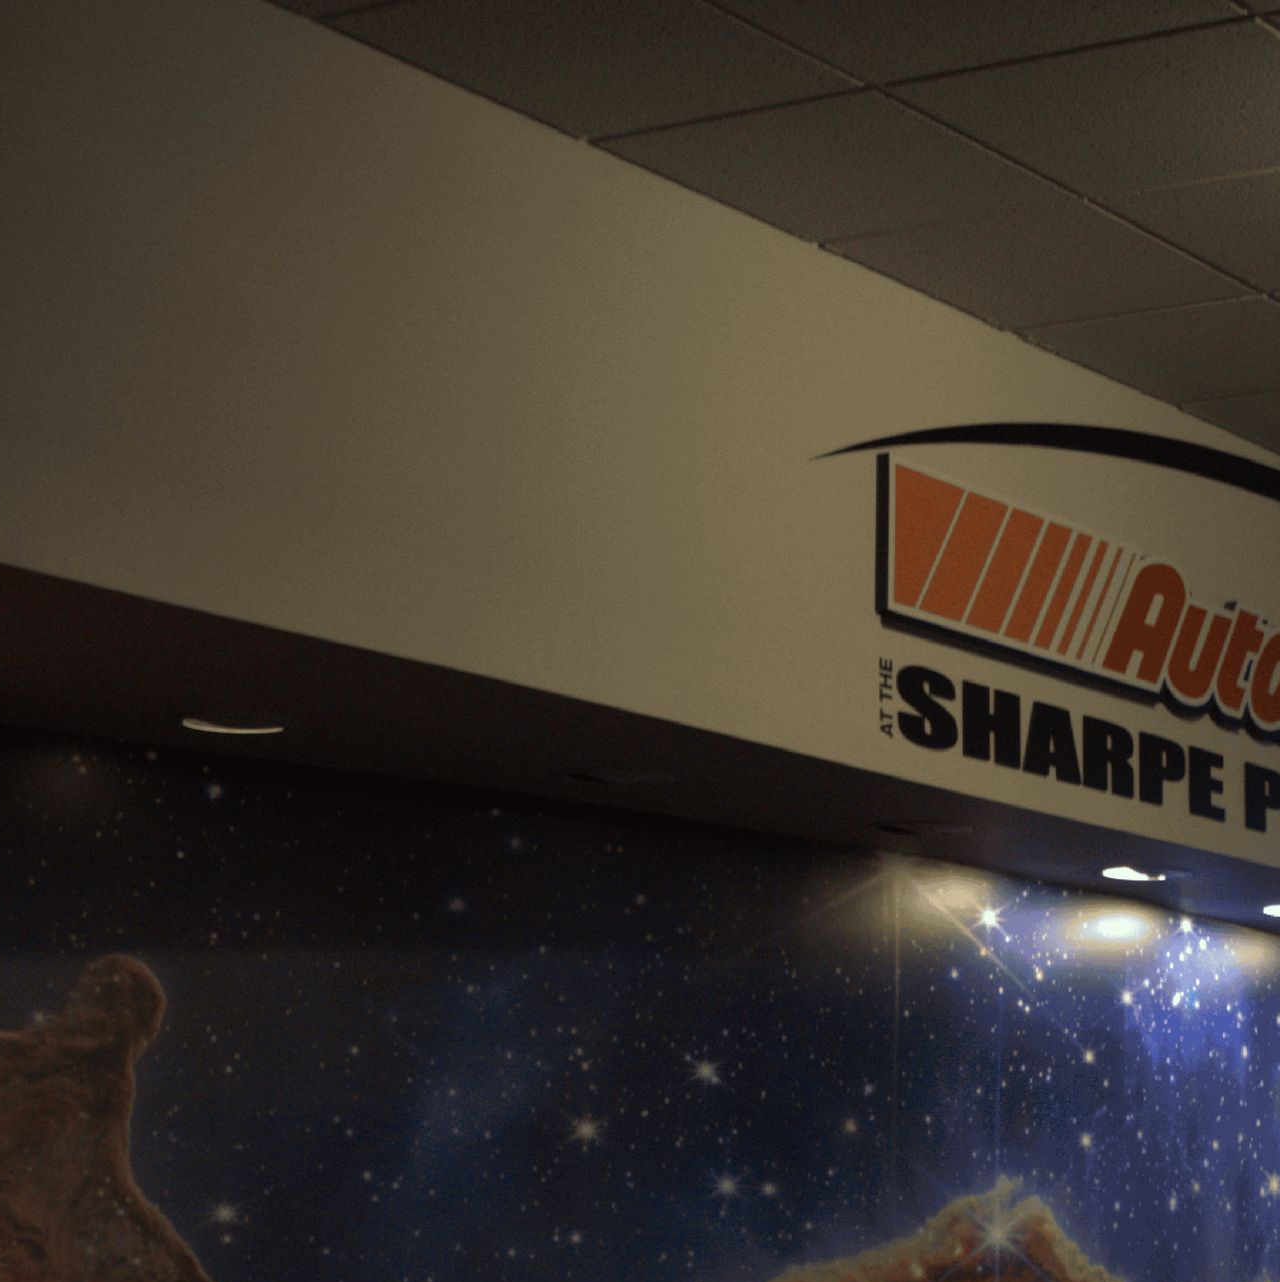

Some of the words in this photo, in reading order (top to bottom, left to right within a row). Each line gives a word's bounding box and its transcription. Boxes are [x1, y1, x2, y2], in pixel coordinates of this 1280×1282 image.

[879, 657, 893, 702] THE
[879, 708, 893, 739] AT
[896, 665, 1225, 822] SHARPE
